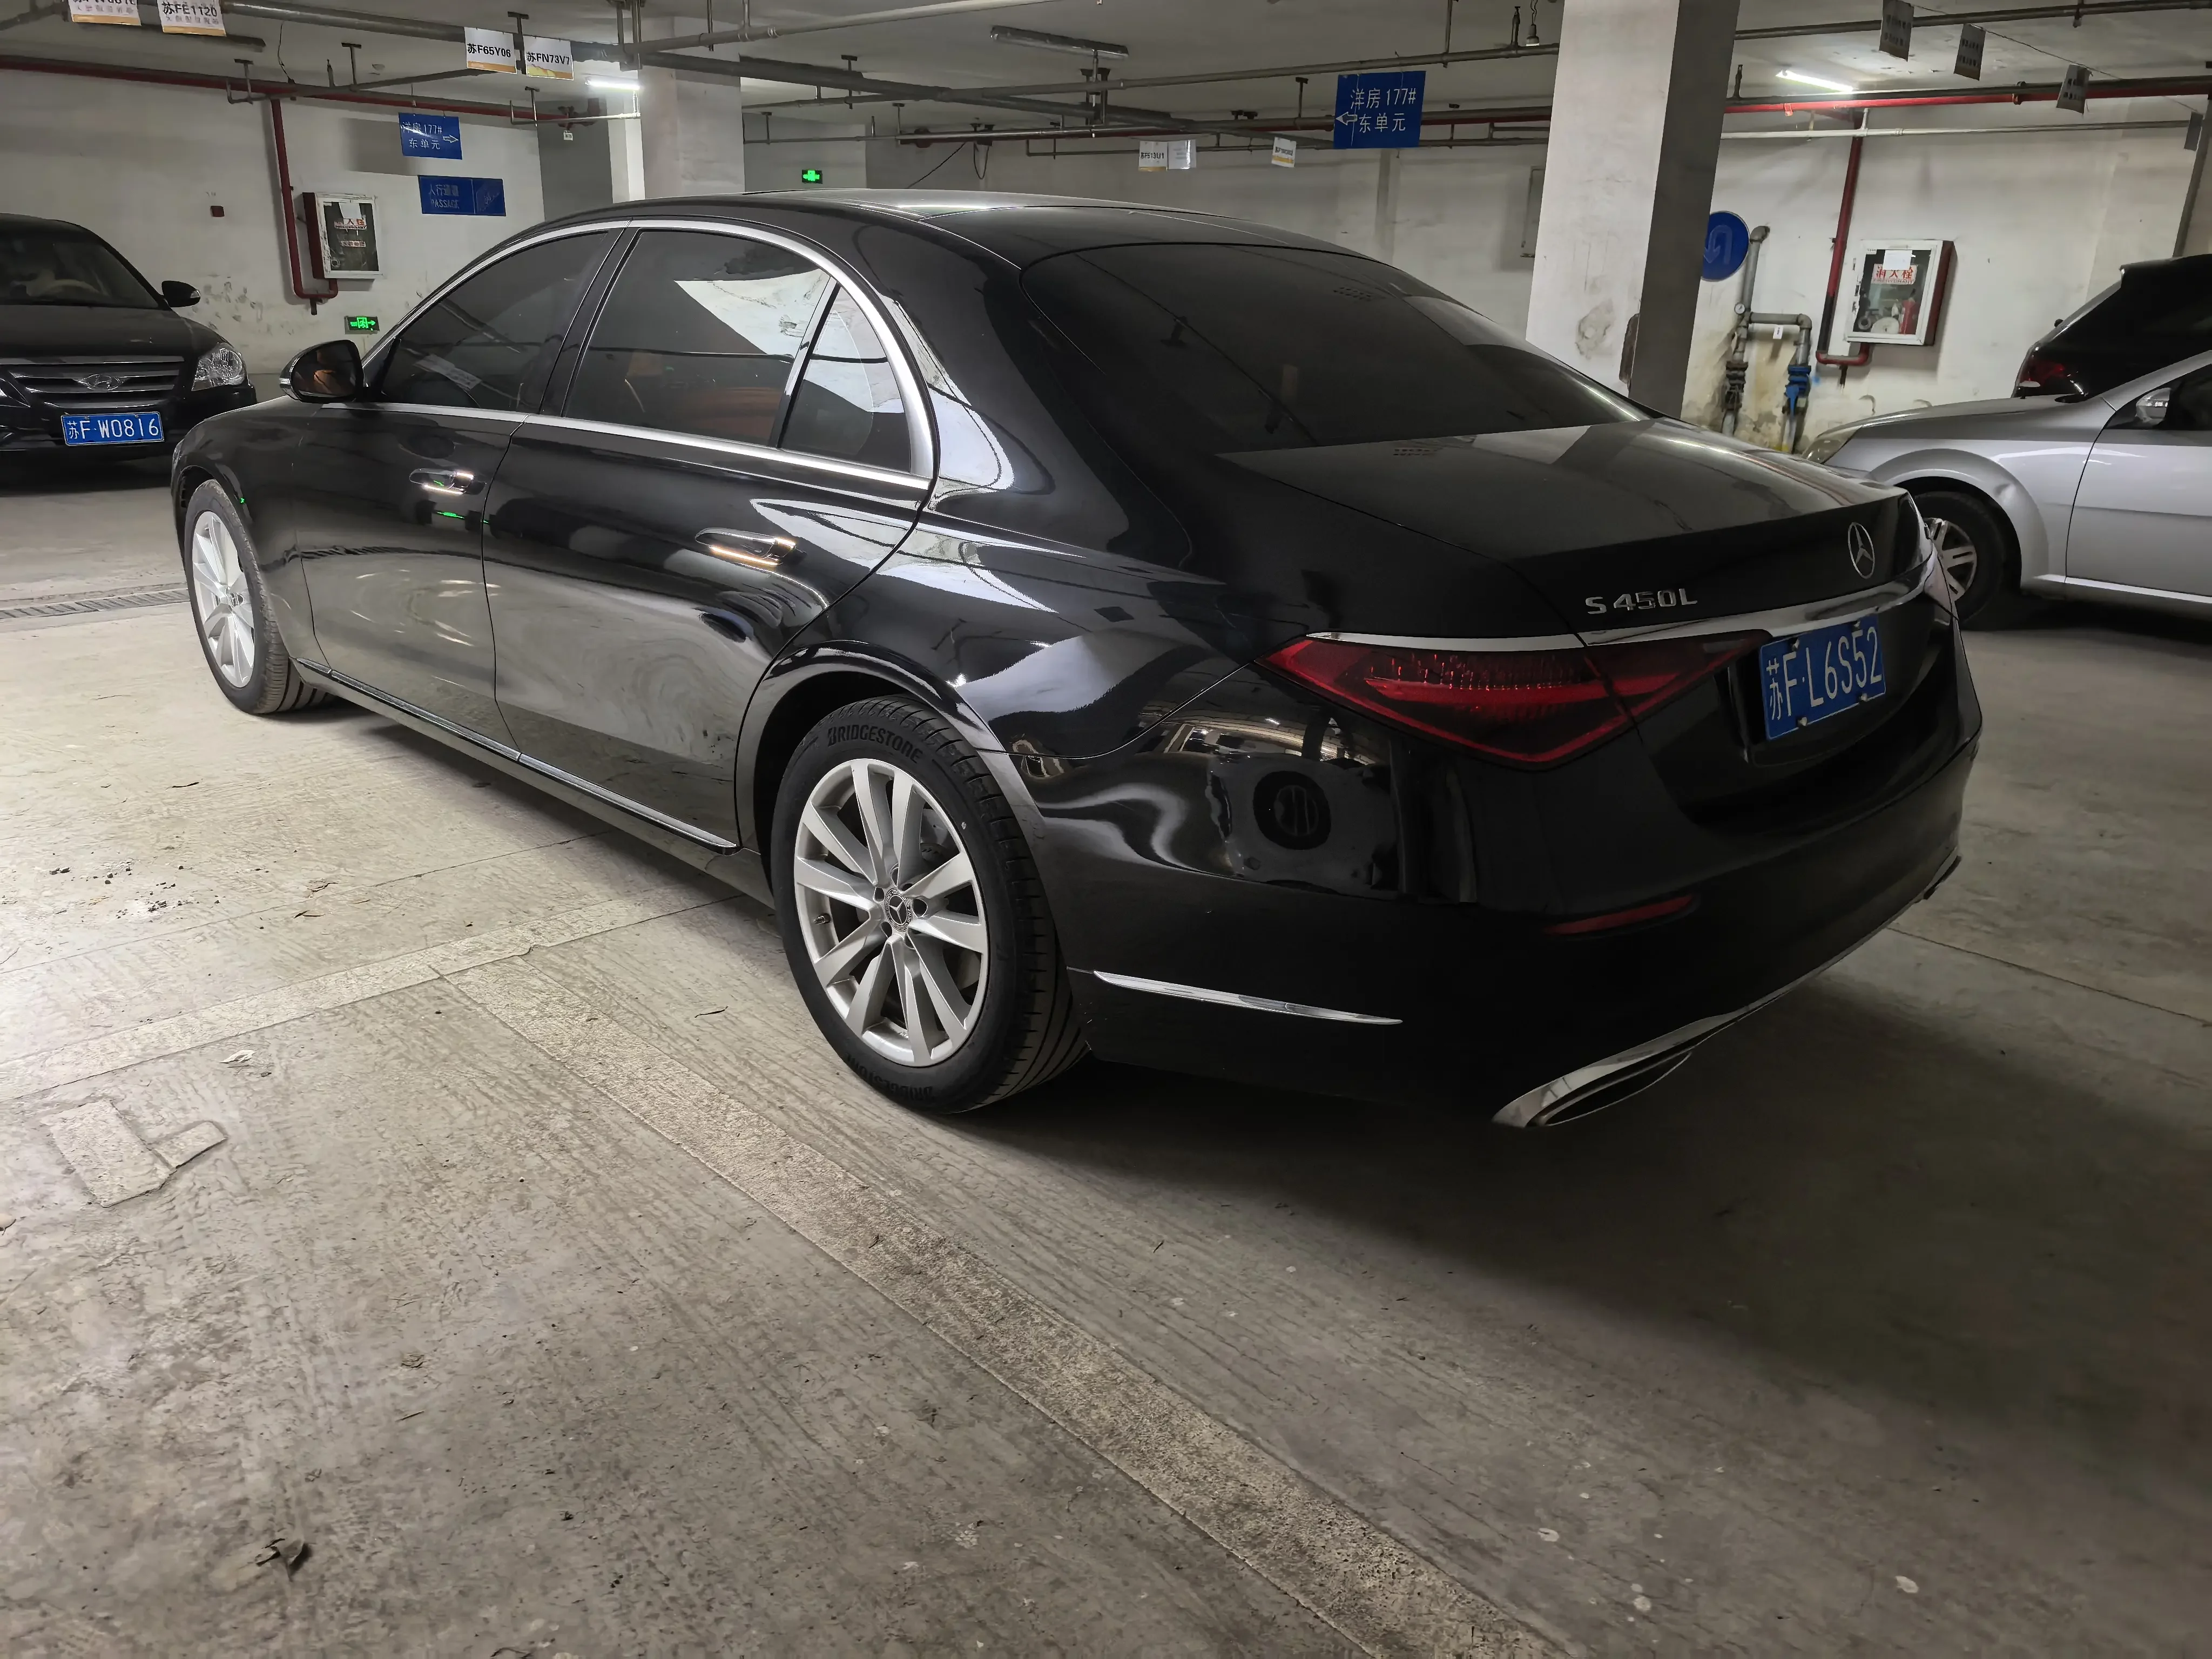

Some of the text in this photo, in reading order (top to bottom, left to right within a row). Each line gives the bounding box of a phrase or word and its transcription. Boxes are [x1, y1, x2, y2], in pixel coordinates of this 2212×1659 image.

[467, 43, 511, 58] 苏F65Y06
[526, 51, 570, 65] 苏FN73V7
[1359, 112, 1406, 133] 东单元
[409, 138, 440, 150] 东单元
[1585, 588, 1698, 615] S 450L
[827, 724, 923, 764] BRIDGESTONE
